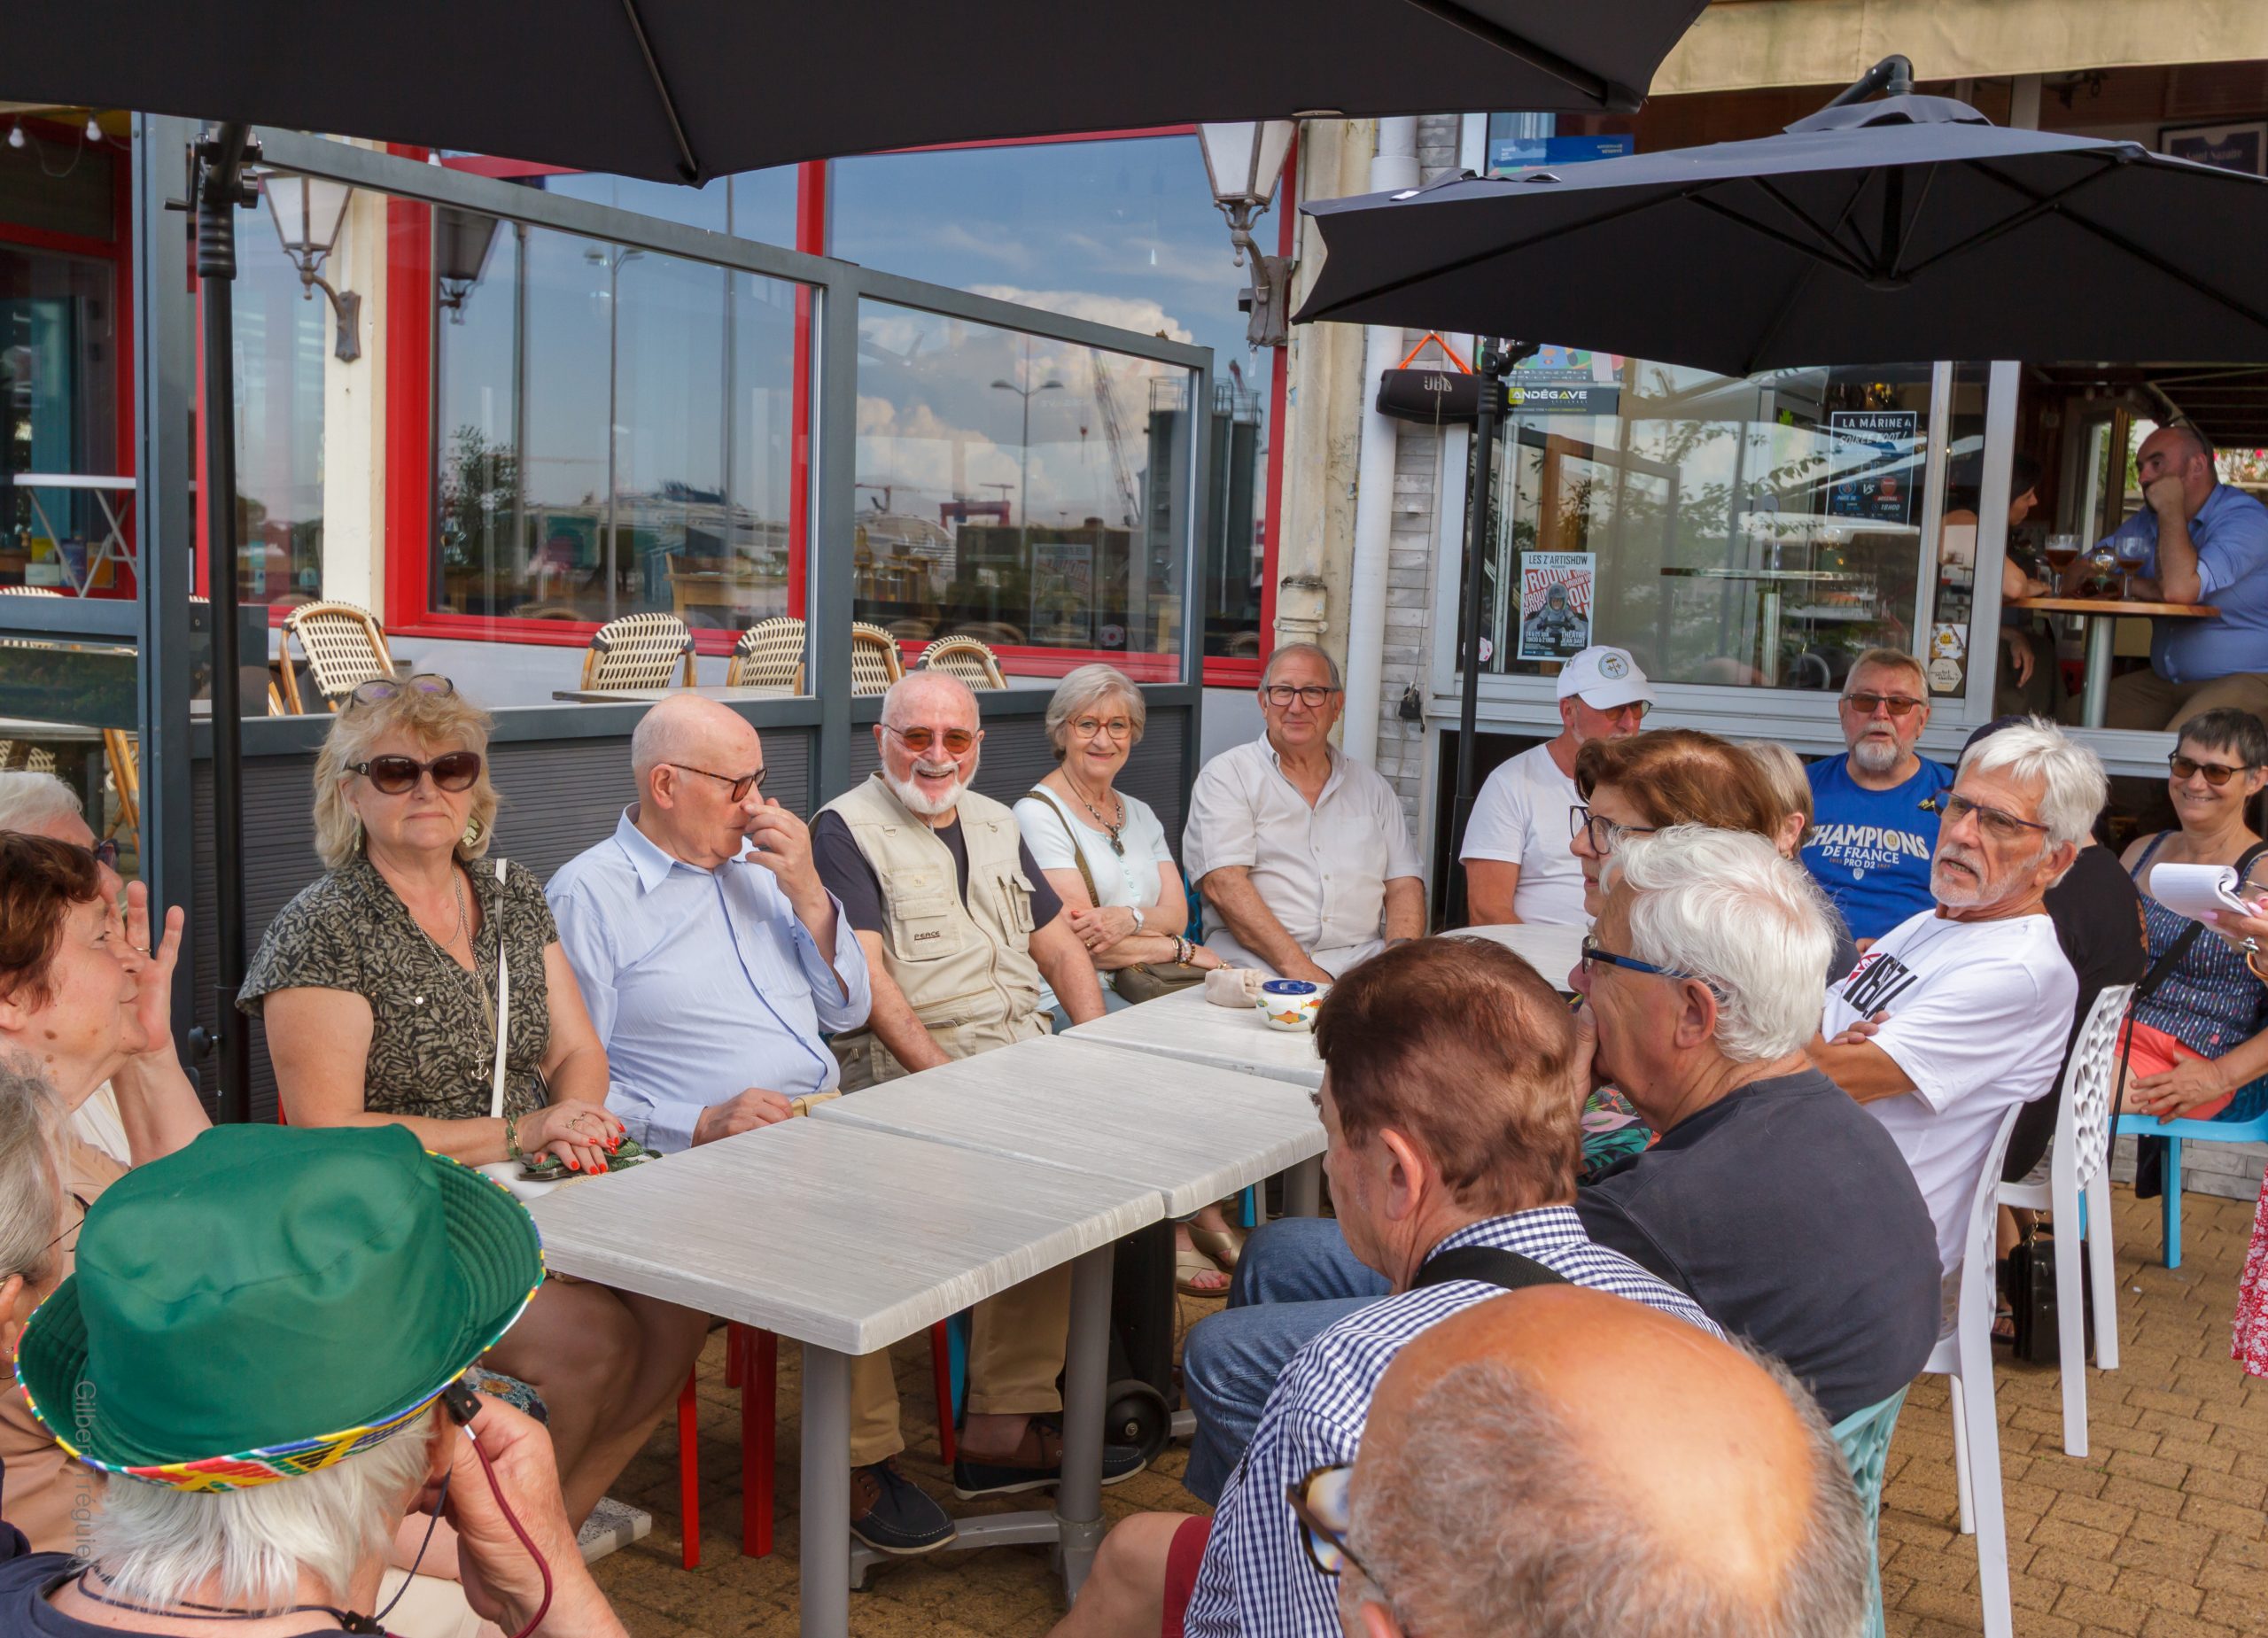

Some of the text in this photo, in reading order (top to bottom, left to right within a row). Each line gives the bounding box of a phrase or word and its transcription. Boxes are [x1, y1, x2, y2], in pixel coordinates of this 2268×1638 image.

[1424, 375, 1453, 392] JBL
[1511, 388, 1588, 400] ANDÉGAVE
[1843, 417, 1903, 428] LA MARINE
[1862, 483, 1876, 496] VS
[1528, 555, 1588, 565] LES Z'ARTISHOW
[1821, 845, 1900, 865] DE FRANCE
[1843, 858, 1862, 867] PRO
[1863, 859, 1876, 869] D2
